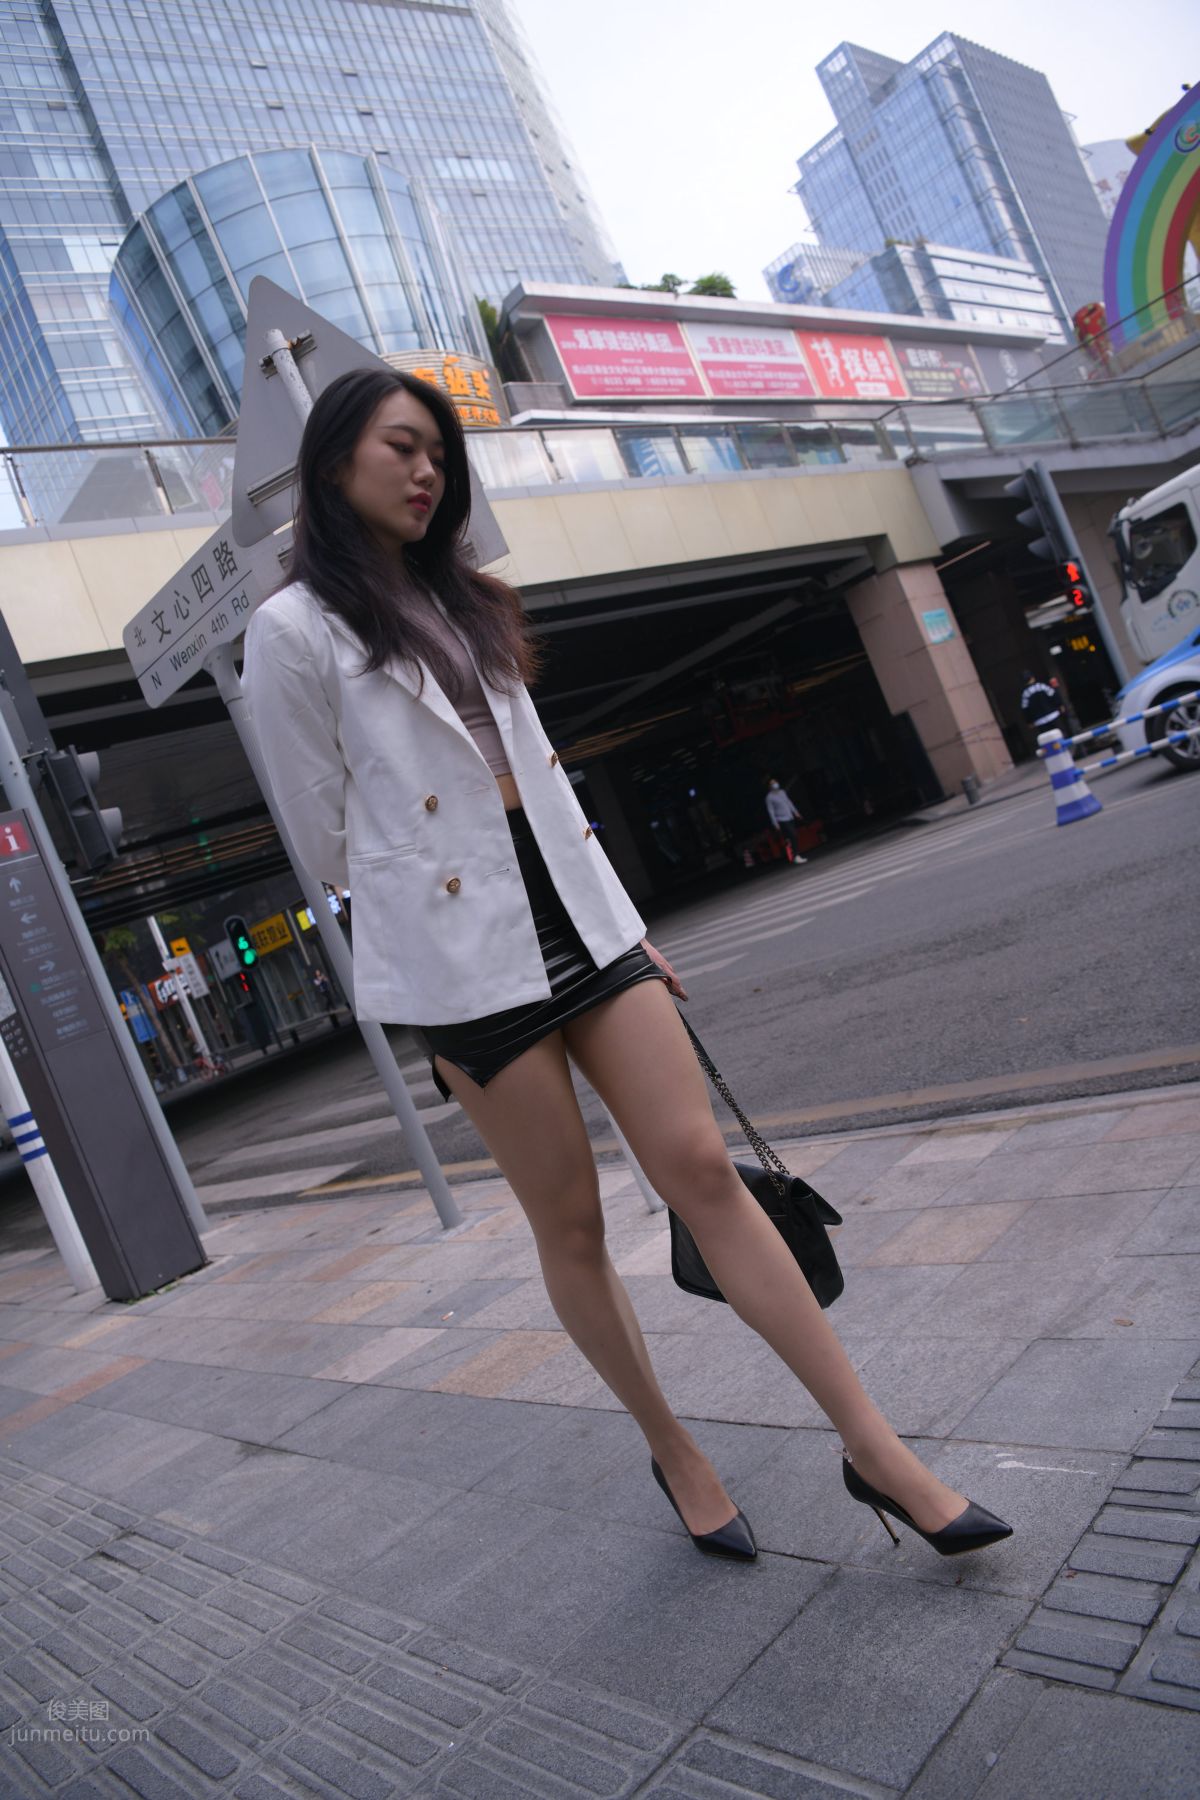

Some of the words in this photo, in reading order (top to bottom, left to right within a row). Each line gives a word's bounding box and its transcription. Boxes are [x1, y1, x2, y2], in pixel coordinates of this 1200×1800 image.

[134, 626, 147, 648] 北
[151, 541, 238, 643] 文心四路
[151, 672, 162, 690] N
[169, 633, 208, 672] Wenxin
[211, 612, 229, 635] 4th
[231, 590, 250, 616] Rd
